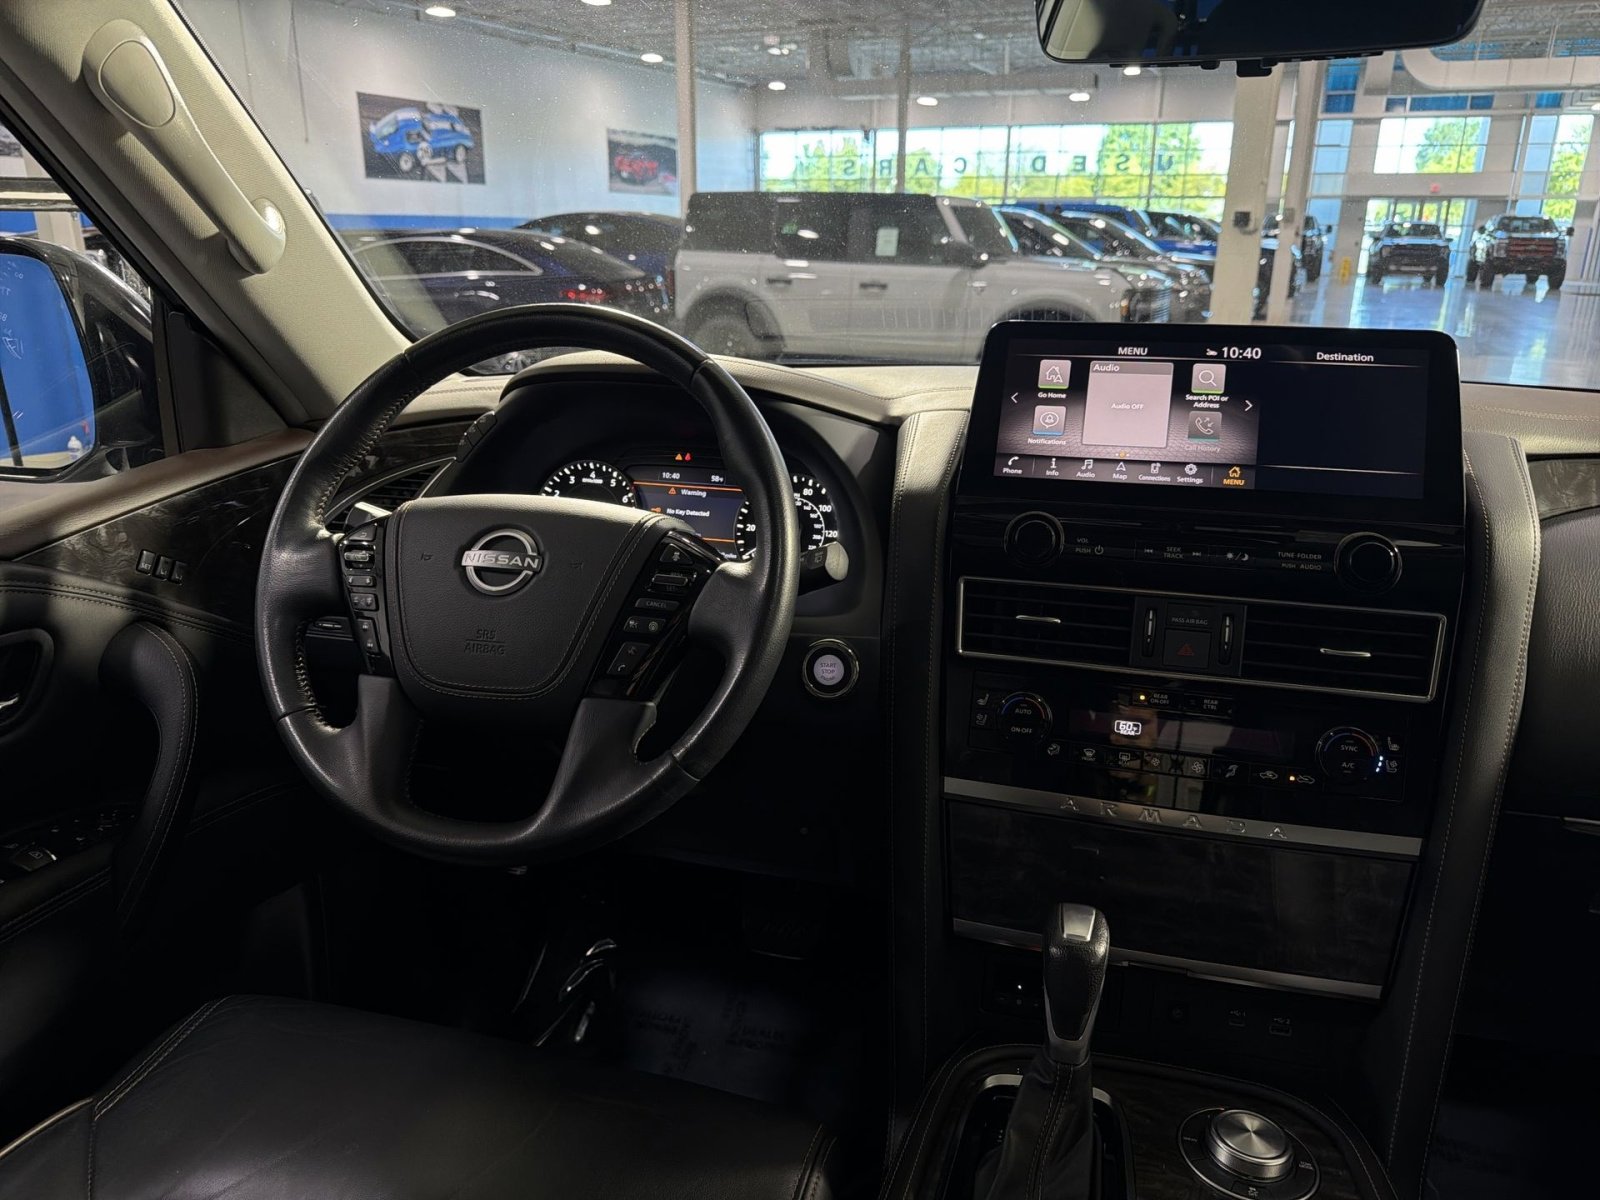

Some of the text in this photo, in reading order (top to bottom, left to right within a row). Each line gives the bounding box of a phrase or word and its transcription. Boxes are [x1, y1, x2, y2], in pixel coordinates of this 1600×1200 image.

[1117, 346, 1149, 356] MENU
[1221, 346, 1262, 360] 10:40
[1316, 351, 1375, 363] Destination
[1092, 363, 1120, 372] Audio
[1037, 391, 1067, 399] Go Home
[1185, 393, 1207, 402] Search
[1110, 402, 1131, 411] Audio
[1193, 401, 1220, 410] Address
[1027, 437, 1067, 446] Notifications
[661, 471, 681, 480] 10:40
[1002, 467, 1023, 475] Phone
[1045, 469, 1060, 477] Info
[1075, 470, 1096, 478] Audio
[568, 475, 576, 485] 3
[1112, 473, 1128, 481] Map
[1138, 473, 1171, 483] Connections
[1176, 475, 1204, 485] Settings
[609, 478, 617, 488] 5
[1222, 478, 1246, 487] MENU
[680, 488, 707, 499] Warning
[802, 487, 814, 497] 80
[621, 495, 629, 504] 6
[675, 508, 685, 517] Key
[685, 509, 711, 517] Detected
[818, 504, 833, 513] 100
[745, 523, 757, 532] 20
[824, 529, 839, 538] 120
[464, 551, 540, 569] NISSAN
[1299, 563, 1322, 571] AUDIO
[475, 628, 496, 640] SRS
[463, 642, 506, 656] AIRBAG
[1014, 707, 1033, 715] AUTO
[1339, 744, 1359, 753] SYNC
[1060, 797, 1288, 841] ARMADA
